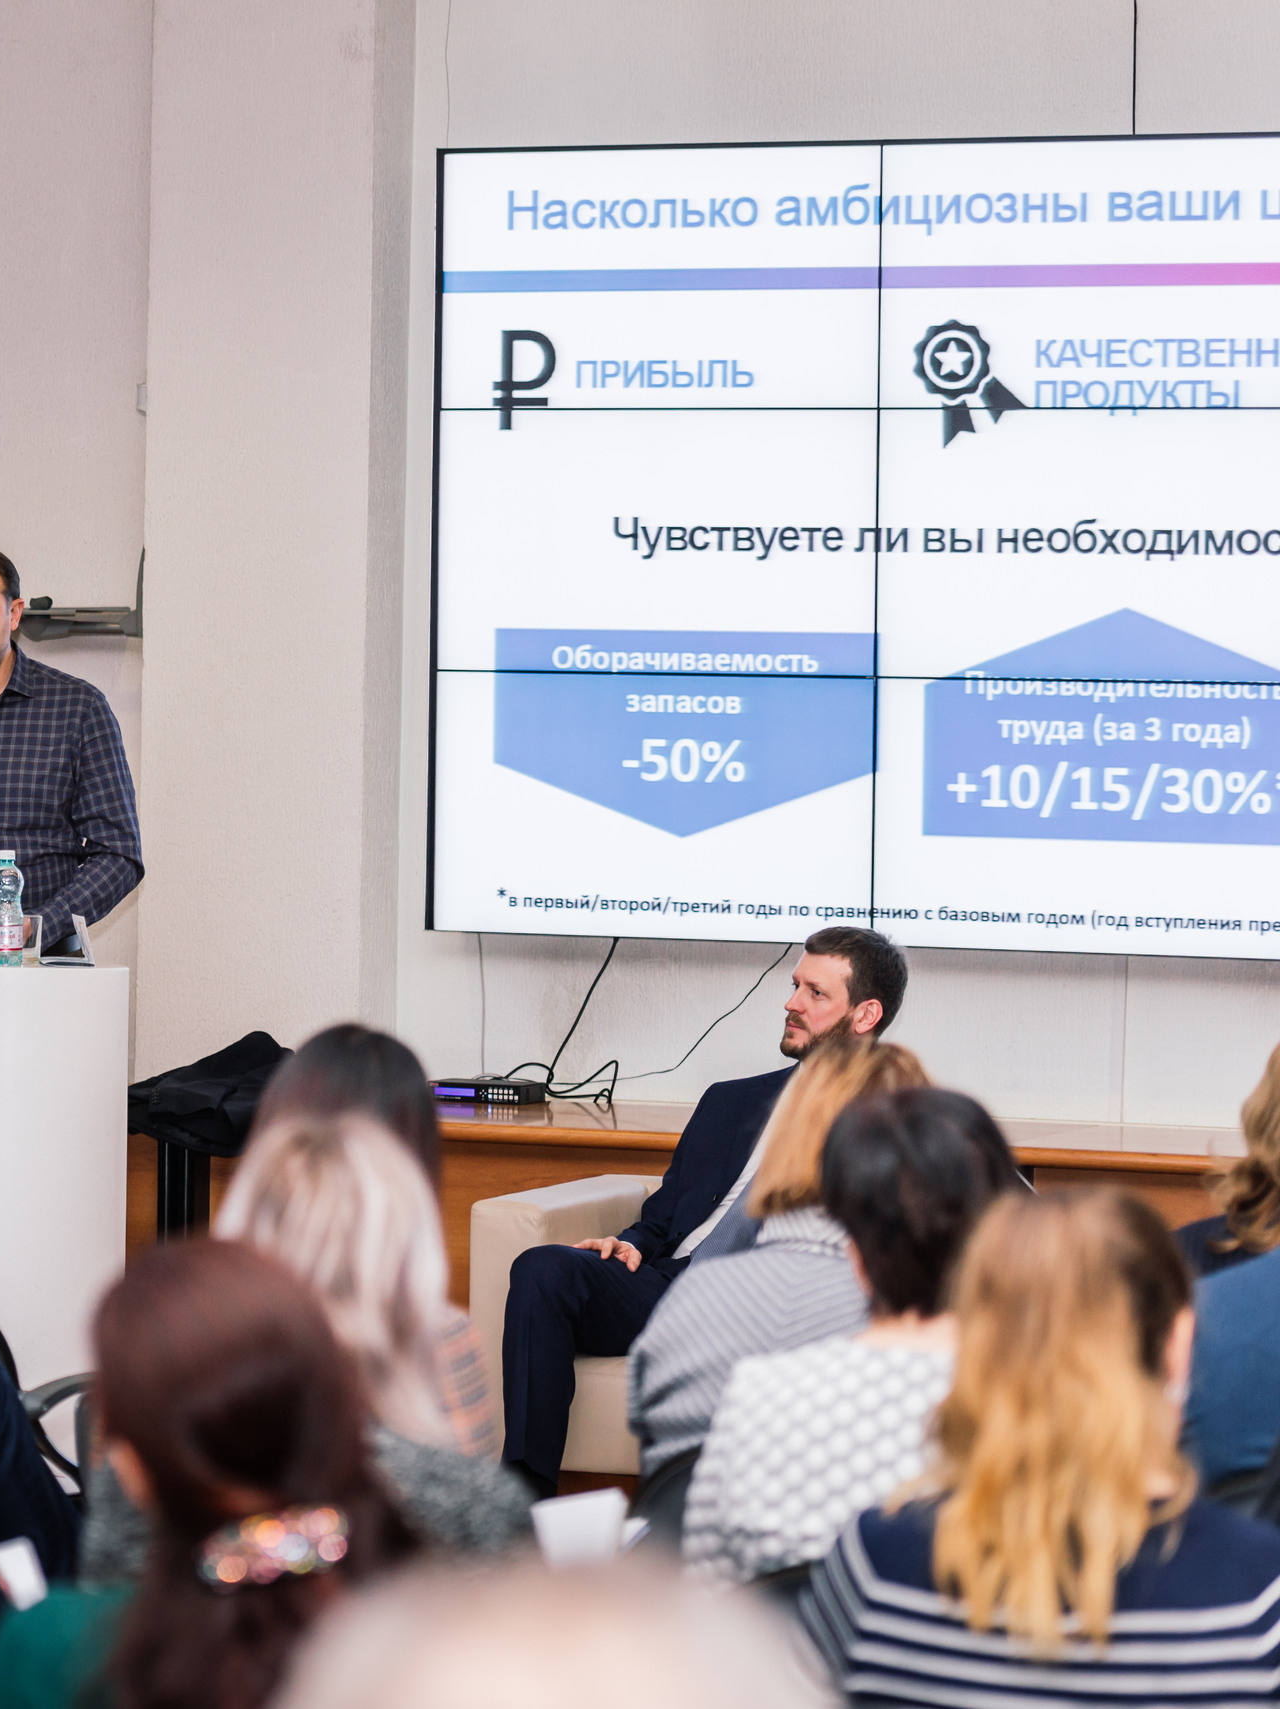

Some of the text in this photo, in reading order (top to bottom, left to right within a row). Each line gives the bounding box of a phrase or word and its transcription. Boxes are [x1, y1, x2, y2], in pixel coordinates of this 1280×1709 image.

[508, 190, 758, 230] Насколько
[775, 183, 1087, 237] амбициозны
[1108, 190, 1240, 222] ваши
[1036, 338, 1280, 368] КАЧЕСТВЕНН
[576, 360, 754, 388] ПРИБЫЛЬ
[1035, 380, 1241, 416] ПРОДУКТЫ
[614, 517, 843, 560] Чувствуете
[854, 526, 908, 554] ли
[924, 528, 983, 553] вы
[552, 644, 819, 672] Оборачиваемость
[626, 695, 742, 714] запасов
[998, 713, 1251, 749] труда (за 3 года)
[622, 739, 745, 782] -50%
[524, 895, 731, 916] первый/второй/третий
[738, 904, 781, 919] годы
[788, 905, 810, 917] по
[816, 905, 919, 925] сравнению
[924, 909, 933, 921] с
[938, 906, 1020, 922] базовым
[1028, 913, 1084, 928] годом
[1092, 910, 1129, 930] (год
[1135, 917, 1241, 932] вступления
